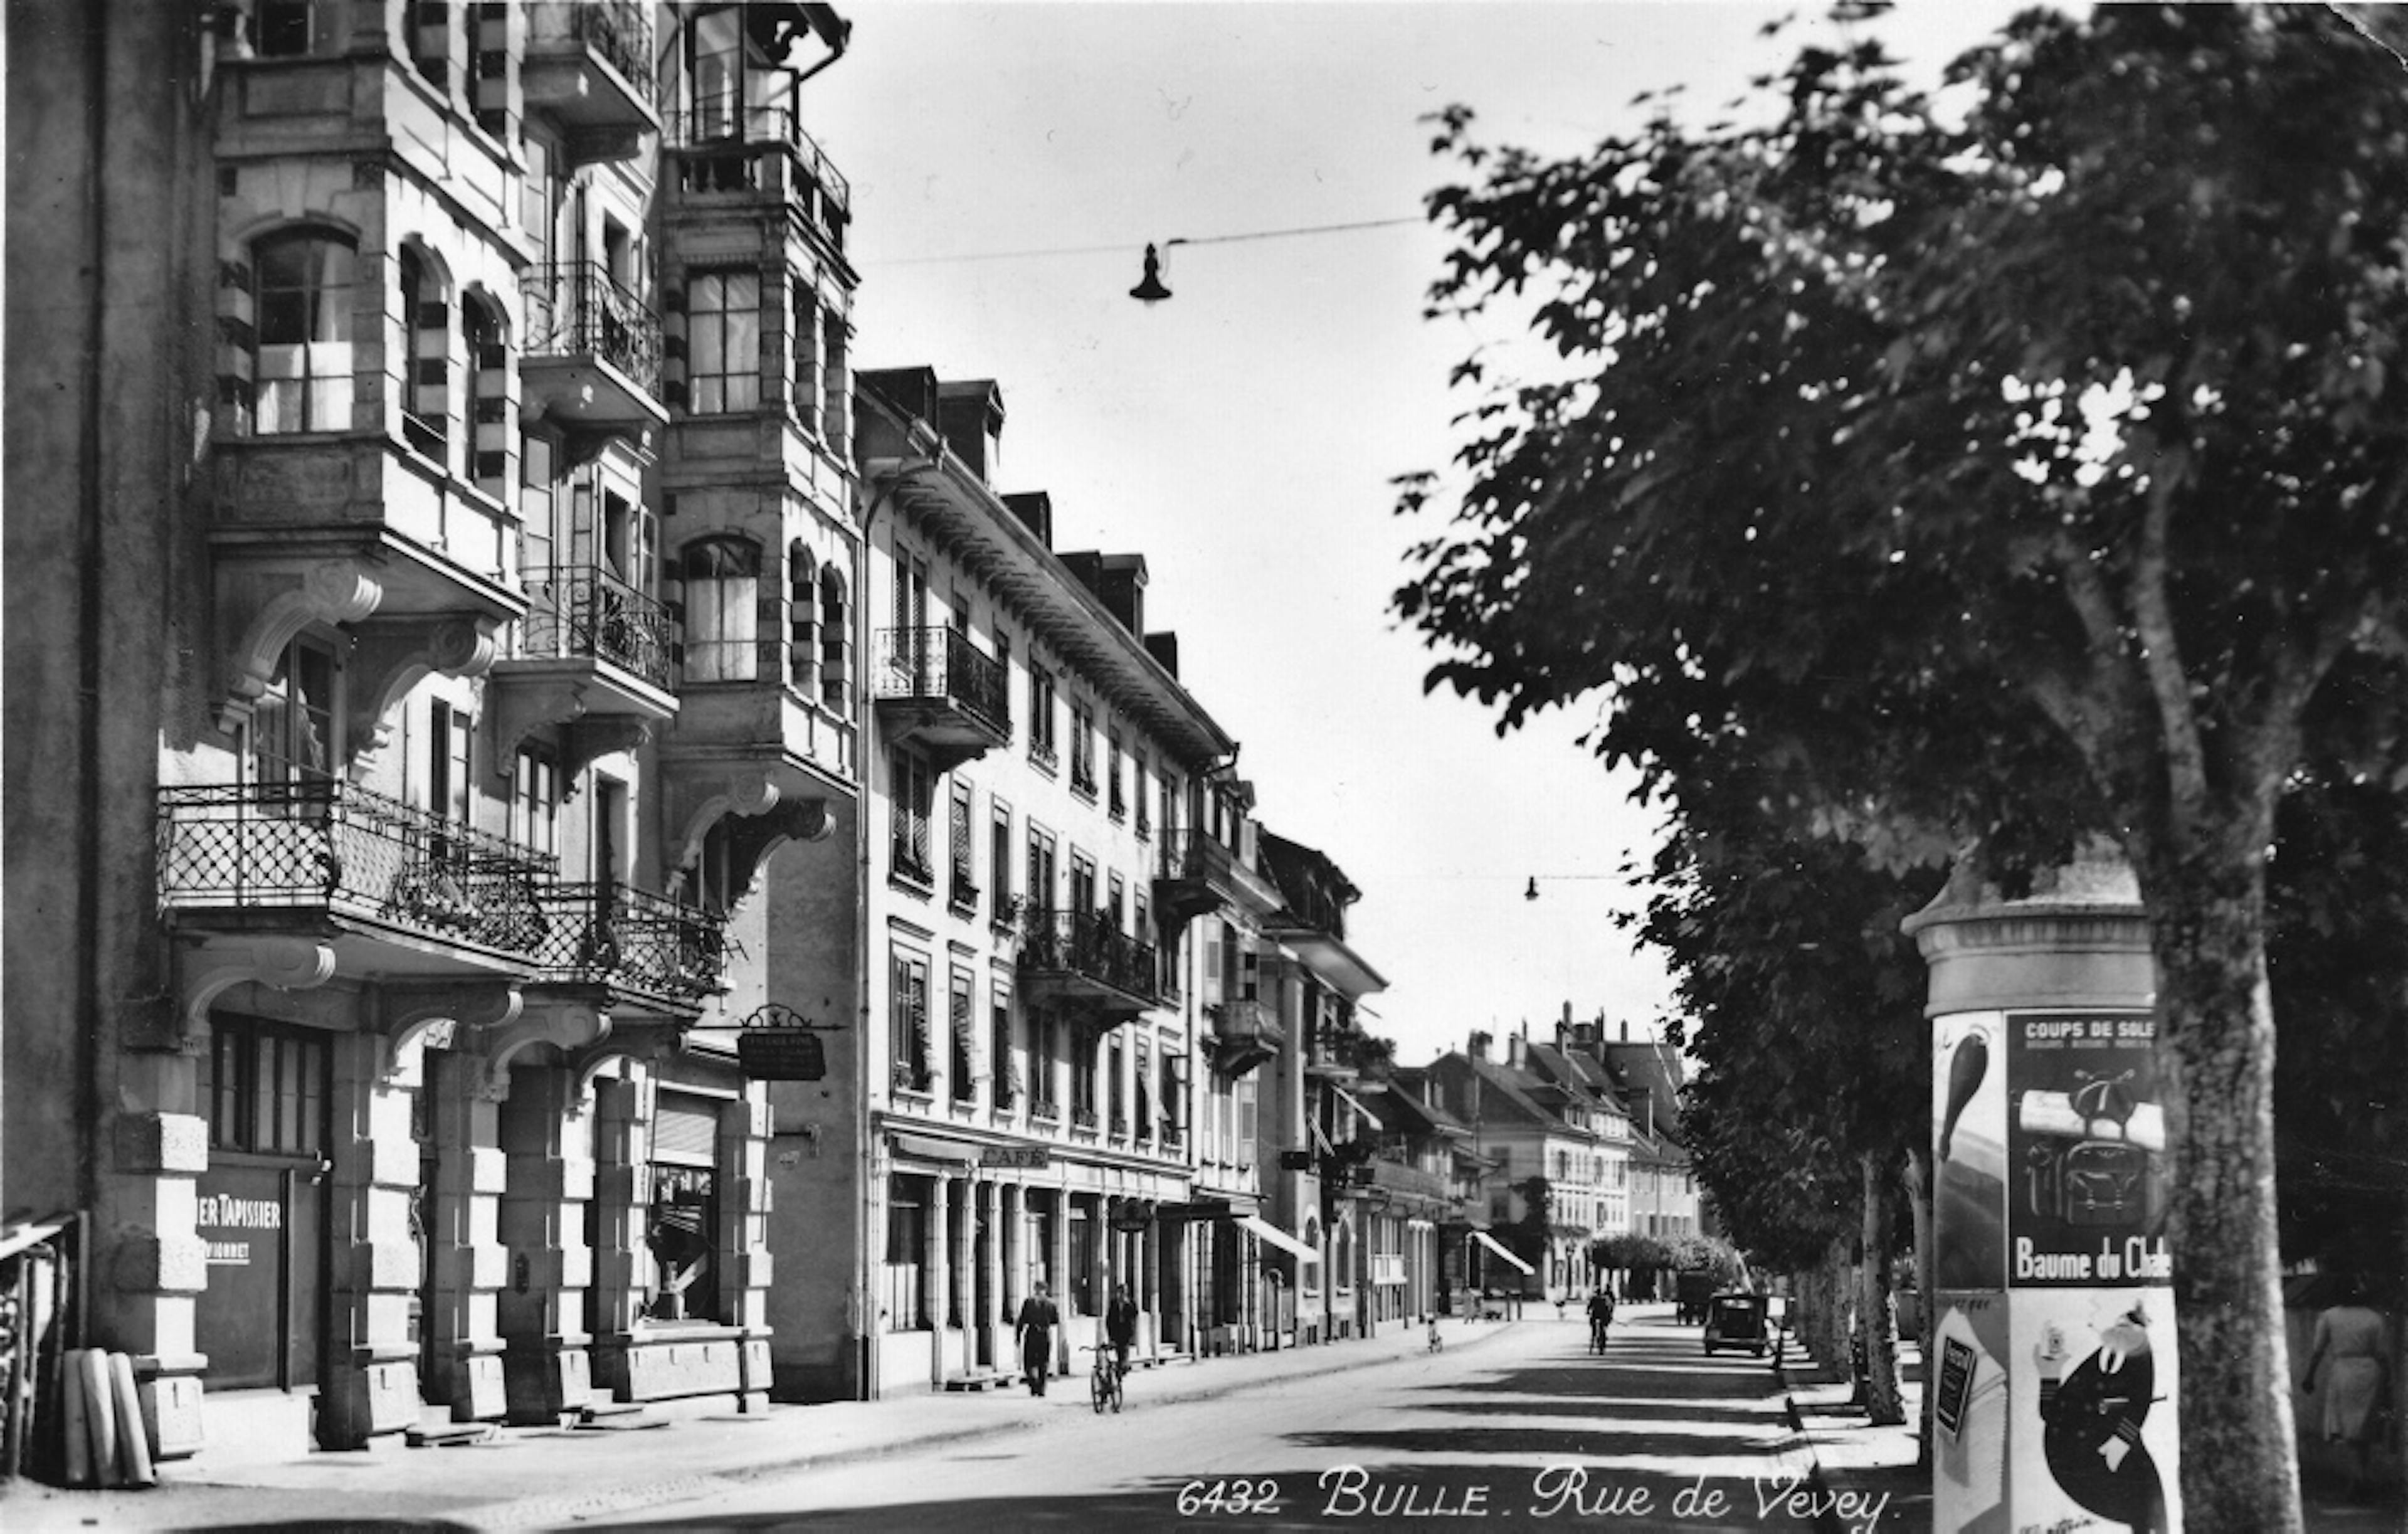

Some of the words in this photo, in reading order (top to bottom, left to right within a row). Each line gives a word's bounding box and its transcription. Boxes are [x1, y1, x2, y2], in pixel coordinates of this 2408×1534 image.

[2025, 1022, 2084, 1038] COUPS
[2090, 1021, 2113, 1037] DE
[983, 1148, 1045, 1165] CAFÉ
[218, 1193, 280, 1229] TAPISSIER
[2016, 1236, 2091, 1278] Baume
[2097, 1236, 2120, 1279] du
